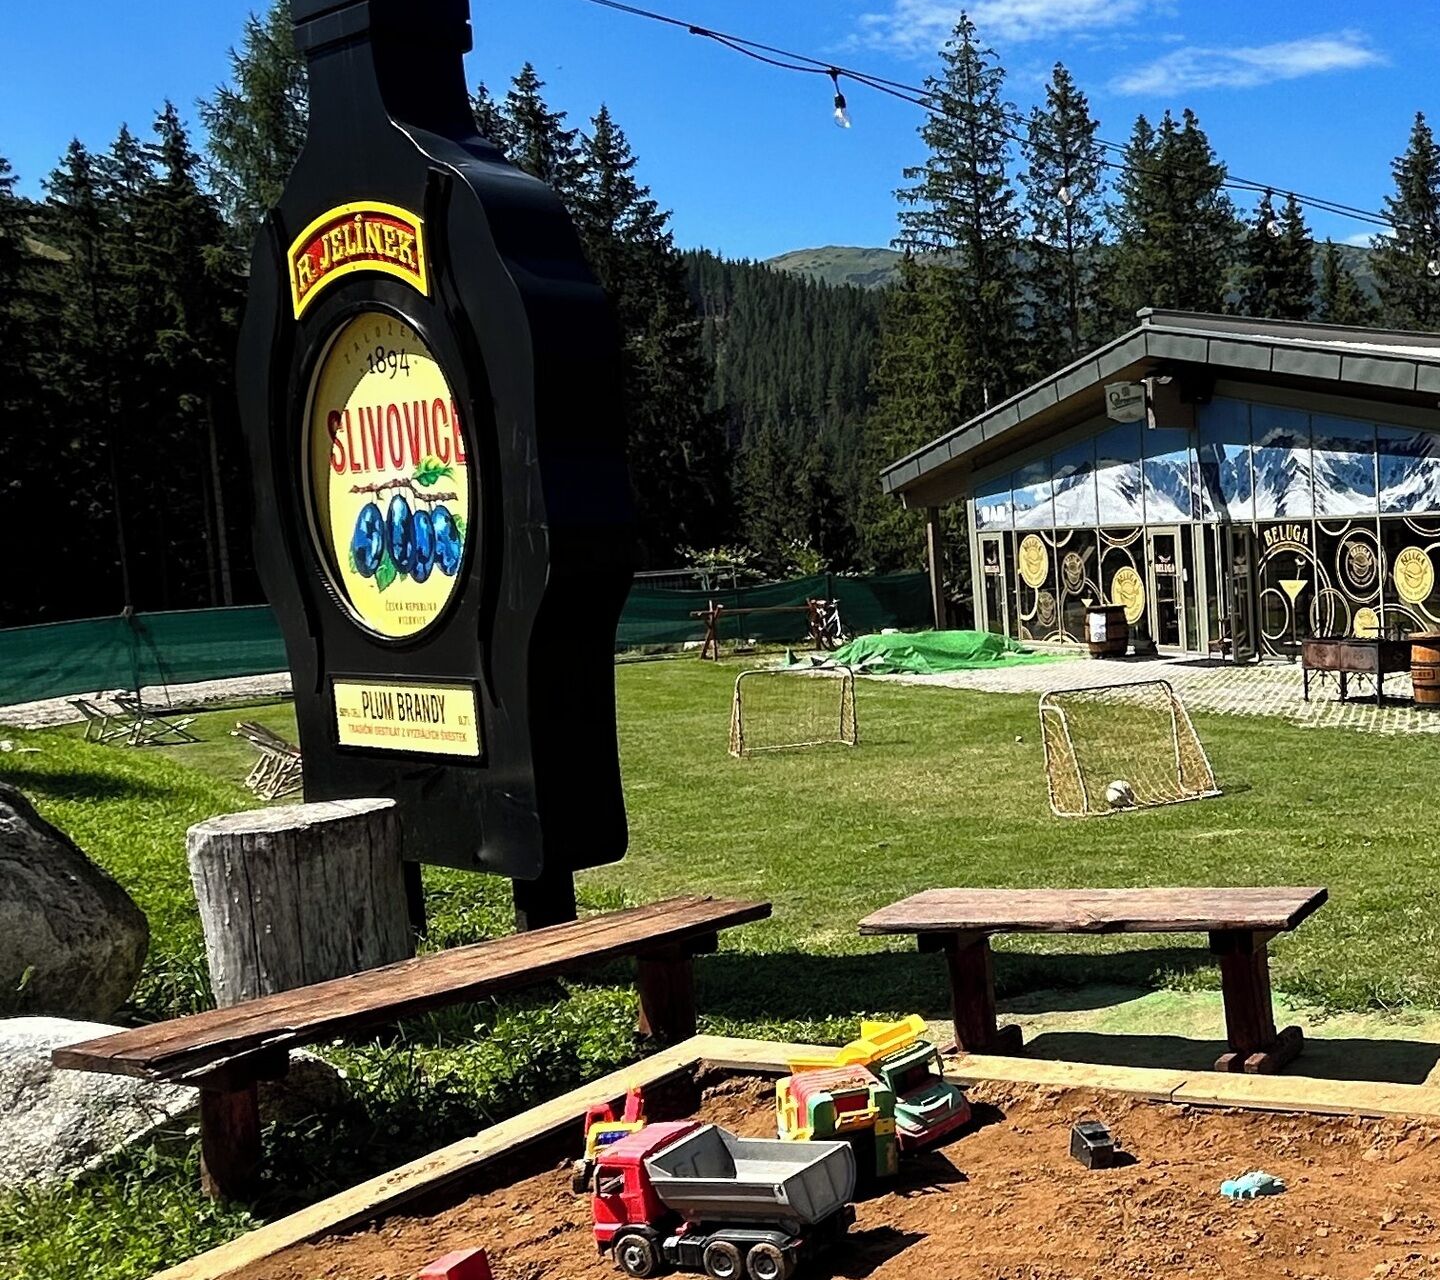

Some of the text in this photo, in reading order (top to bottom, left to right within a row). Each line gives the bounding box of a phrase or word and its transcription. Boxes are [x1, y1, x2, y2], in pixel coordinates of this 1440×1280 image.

[366, 346, 411, 380] 1894
[1263, 523, 1309, 547] BELUGA
[361, 690, 446, 725] PLUM BRANDY
